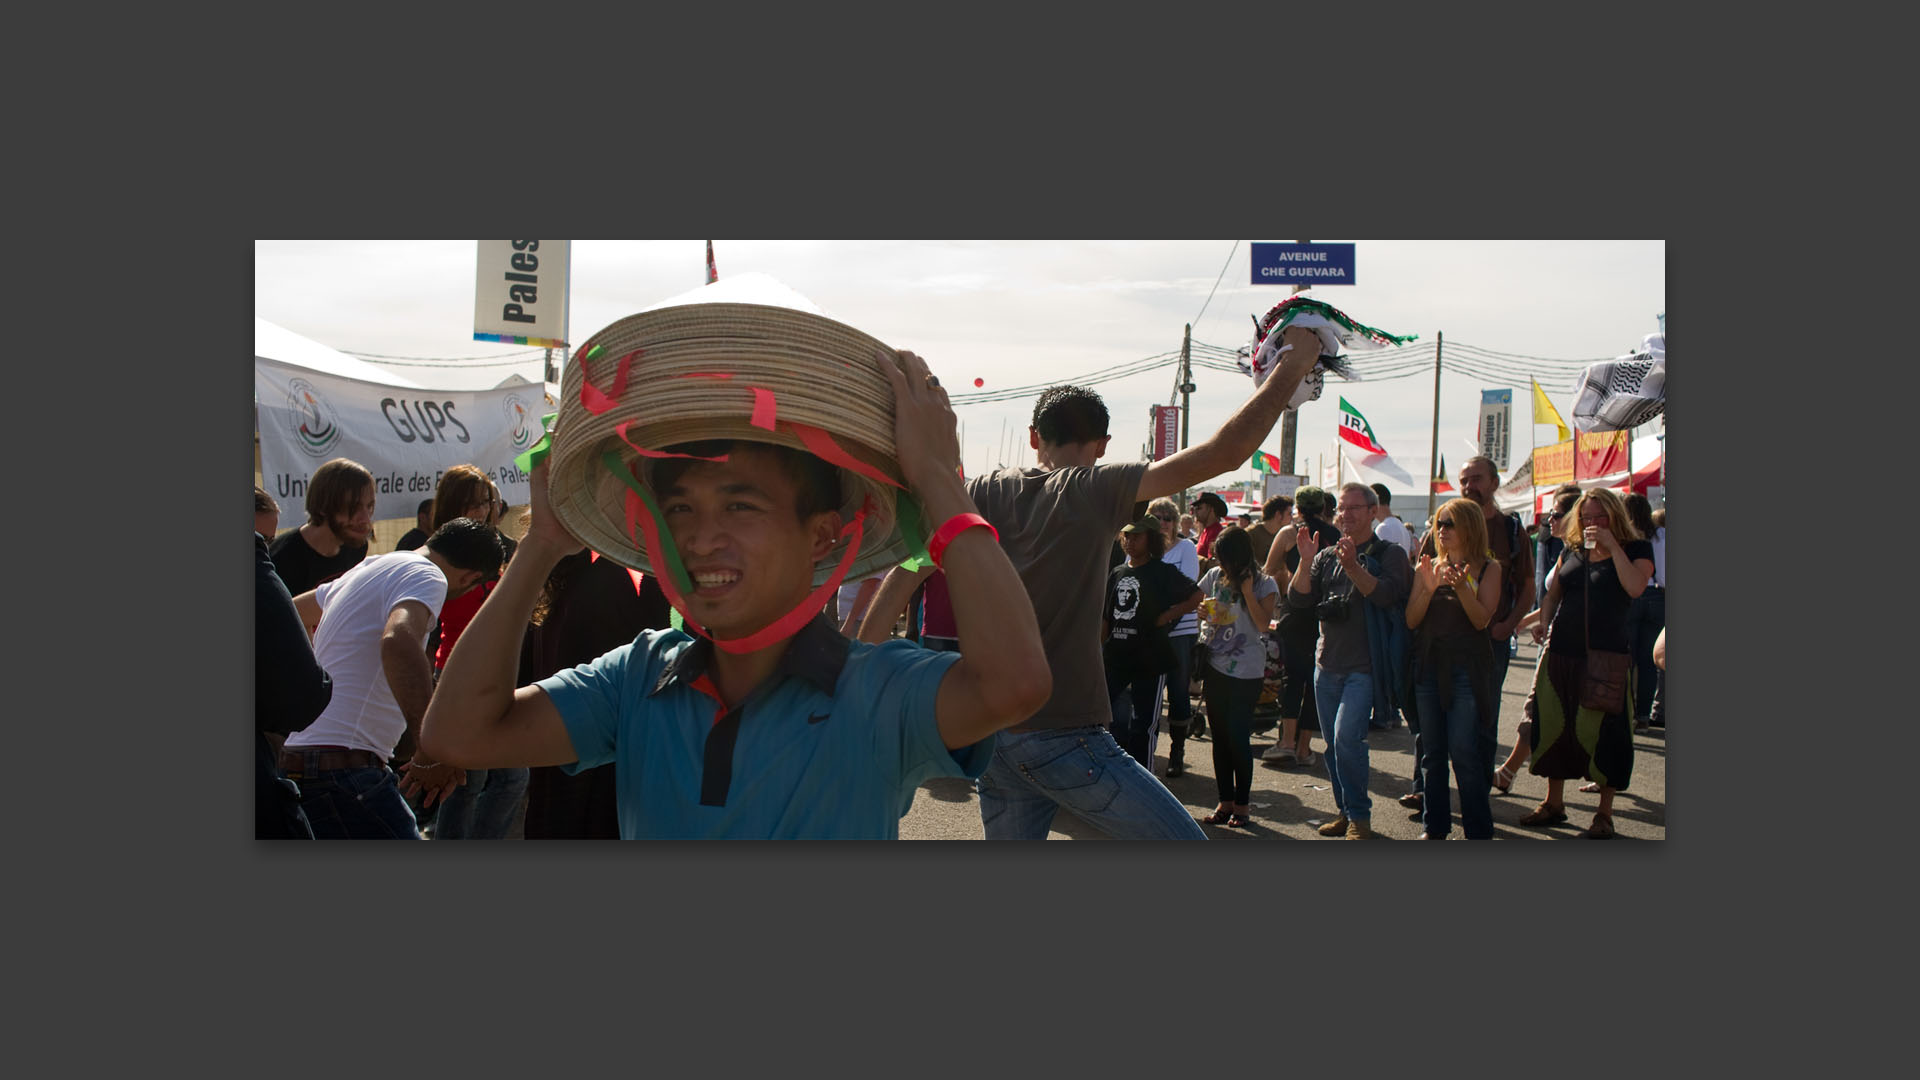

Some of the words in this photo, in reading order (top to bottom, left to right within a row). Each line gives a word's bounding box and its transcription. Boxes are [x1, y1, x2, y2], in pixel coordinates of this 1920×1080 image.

[1261, 267, 1286, 277] CHE
[1288, 267, 1345, 277] GUEVARA
[1279, 252, 1327, 262] AVENUE
[380, 398, 471, 444] GUPS
[1163, 408, 1177, 458] umanité
[277, 473, 308, 498] Uni
[375, 472, 404, 494] rale
[408, 470, 431, 492] des
[500, 466, 530, 485] Pales
